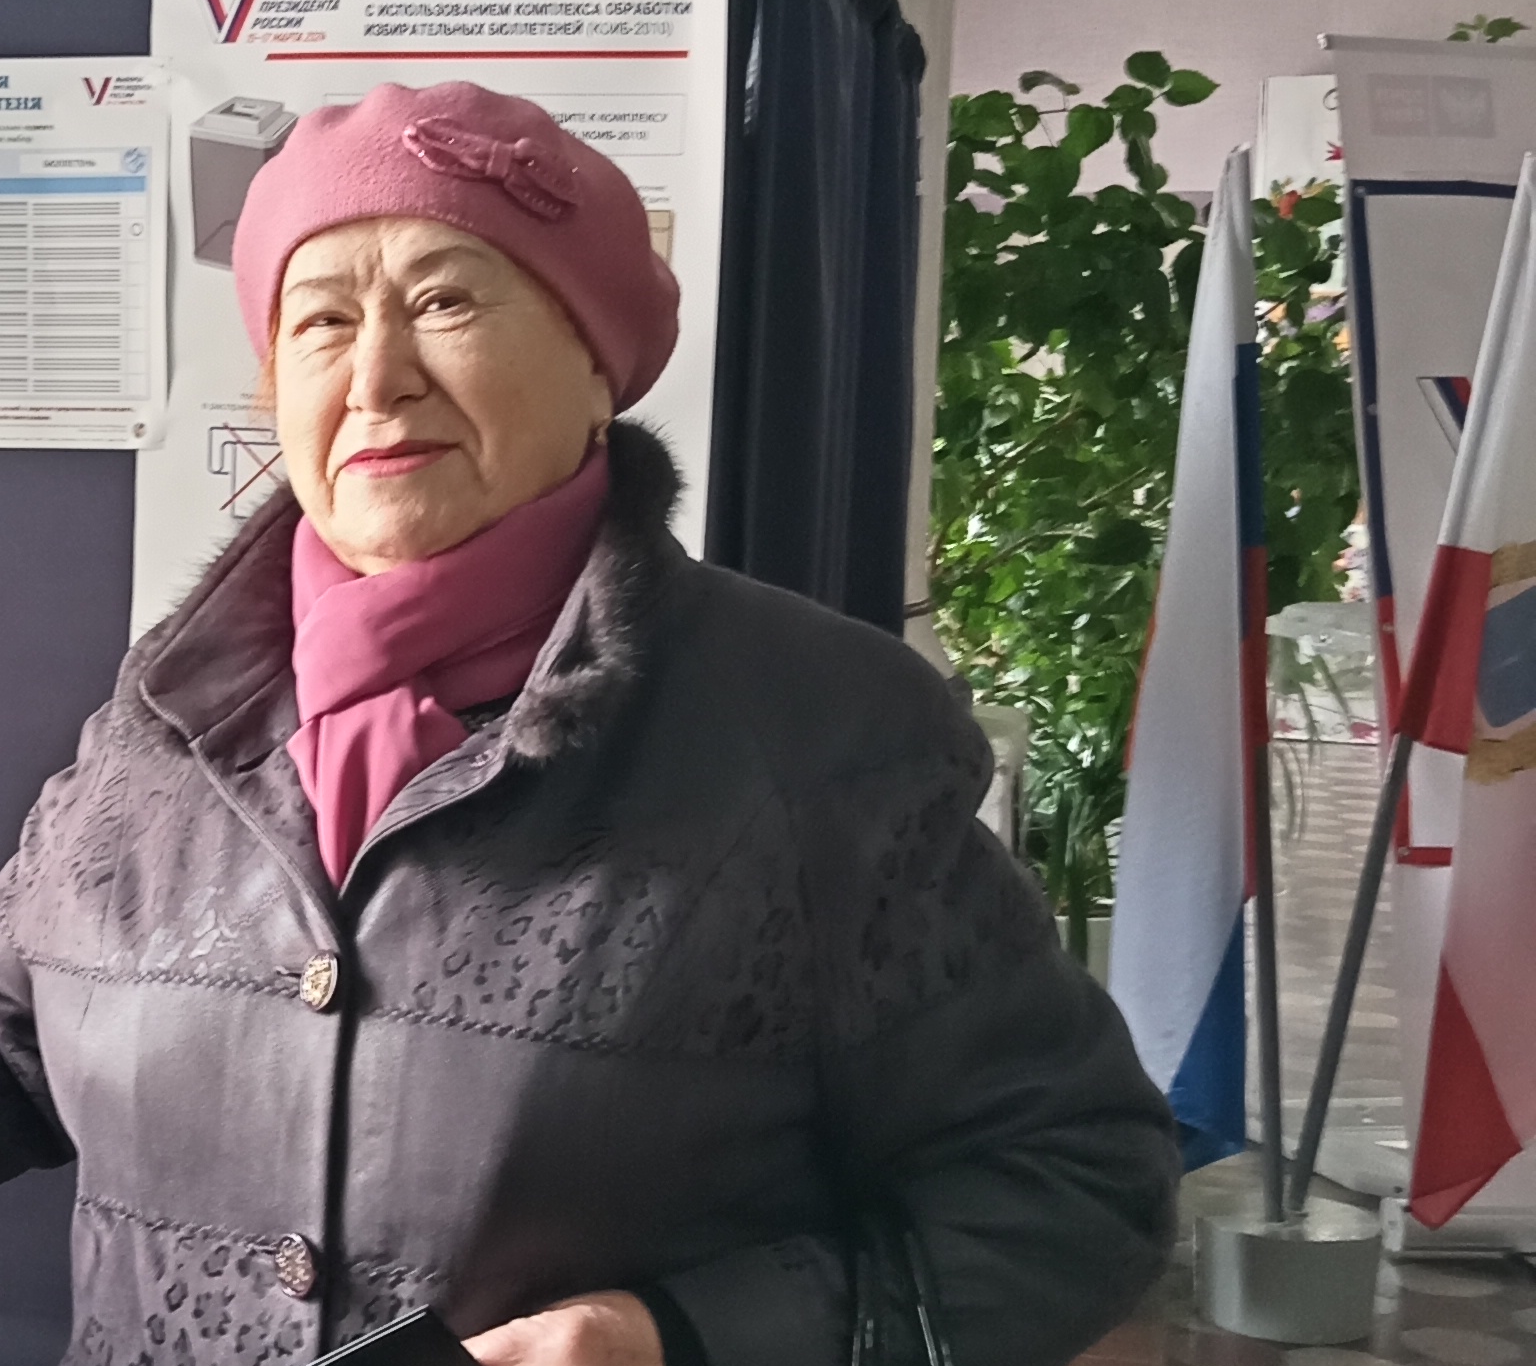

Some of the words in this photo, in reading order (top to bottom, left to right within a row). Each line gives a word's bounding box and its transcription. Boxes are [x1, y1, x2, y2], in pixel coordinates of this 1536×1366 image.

[377, 3, 511, 17] ИСПОЛЬЗОВАНИЕМ
[515, 2, 600, 16] КОМПЛЕКСА
[605, 1, 692, 16] ОБРАБОТКИ
[251, 15, 305, 30] РОССИИ
[364, 22, 485, 36] ИЗБИРАТЕЛЬНЫХ
[488, 20, 583, 36] БЮЛЛЕТЕНЕЙ
